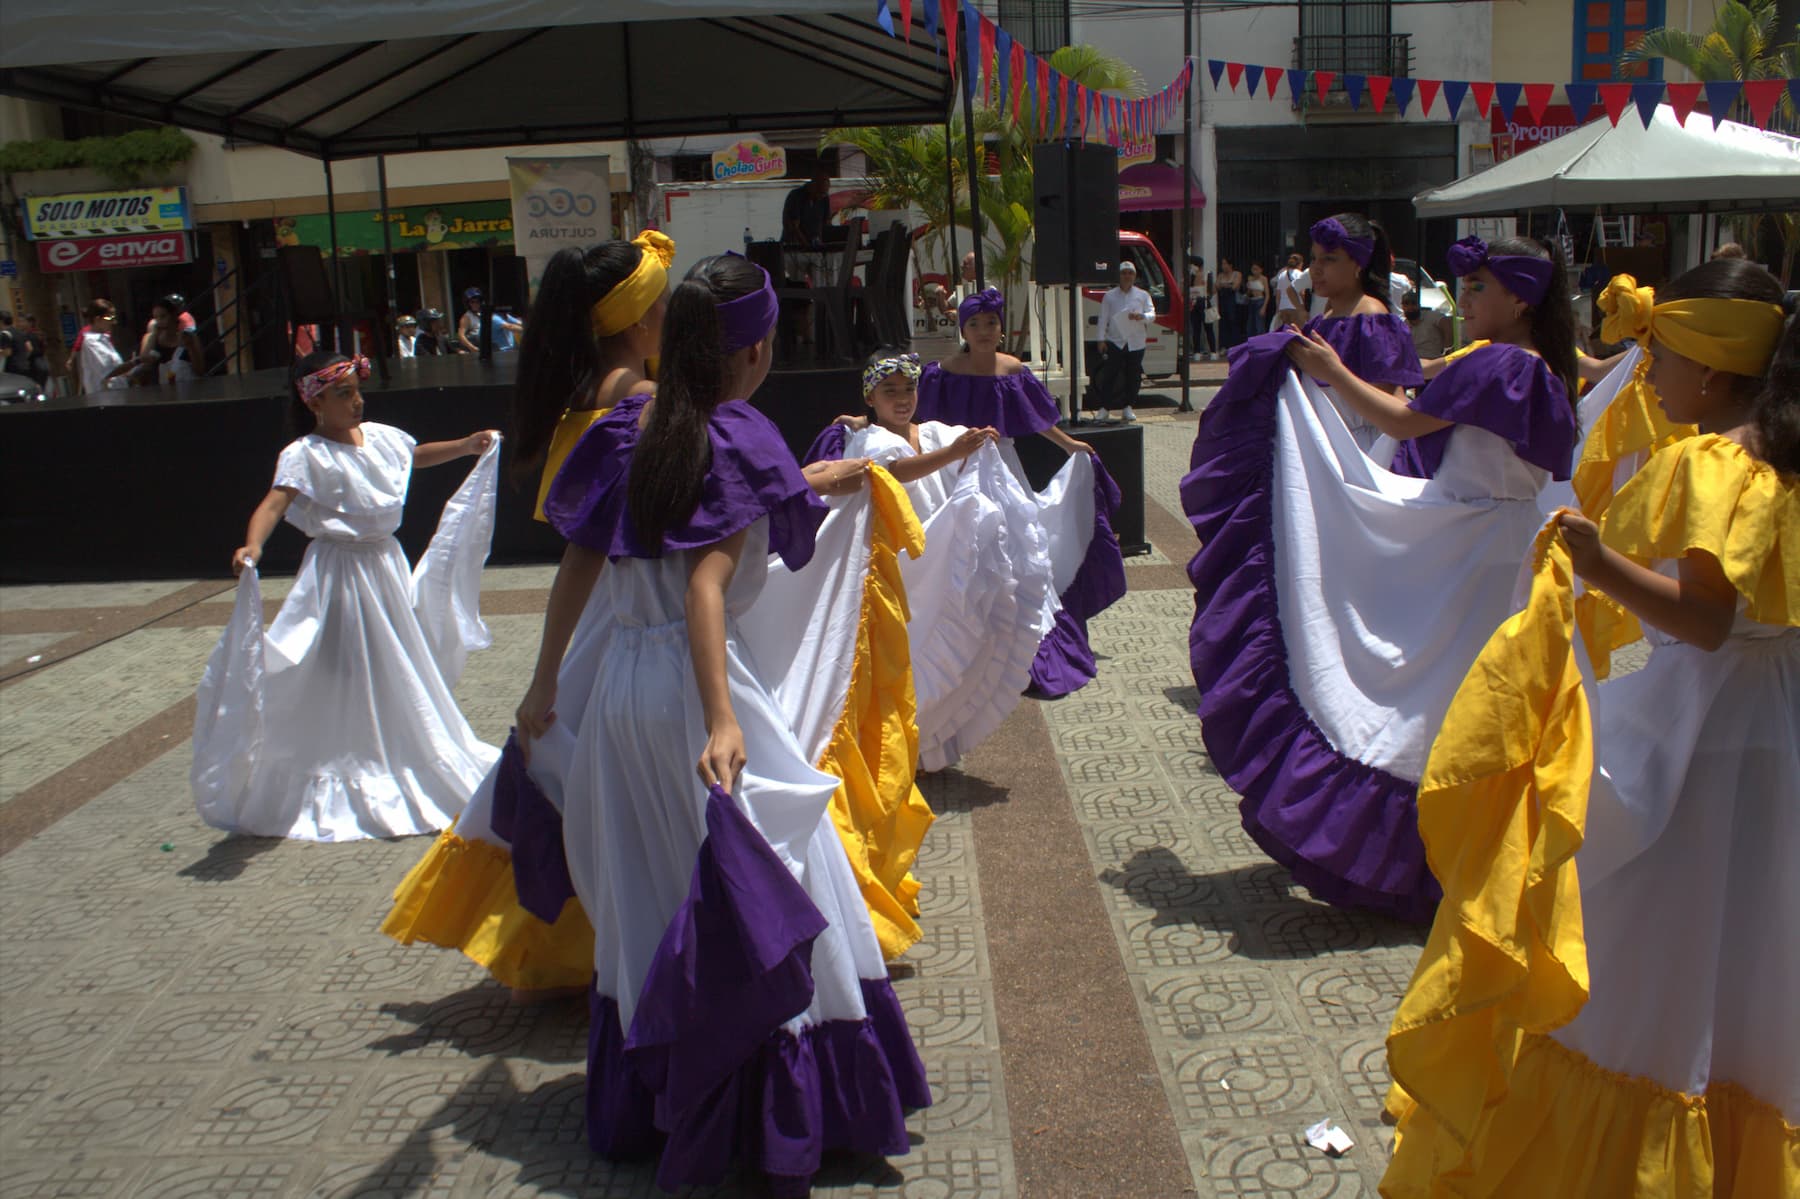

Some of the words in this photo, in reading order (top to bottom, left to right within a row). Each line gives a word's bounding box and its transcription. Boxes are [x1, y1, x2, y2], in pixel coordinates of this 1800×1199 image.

[37, 200, 85, 222] SOLO
[86, 196, 153, 219] MOTOS
[39, 218, 149, 230] PARQUEADERO
[399, 221, 426, 237] La
[449, 217, 512, 233] Jarra
